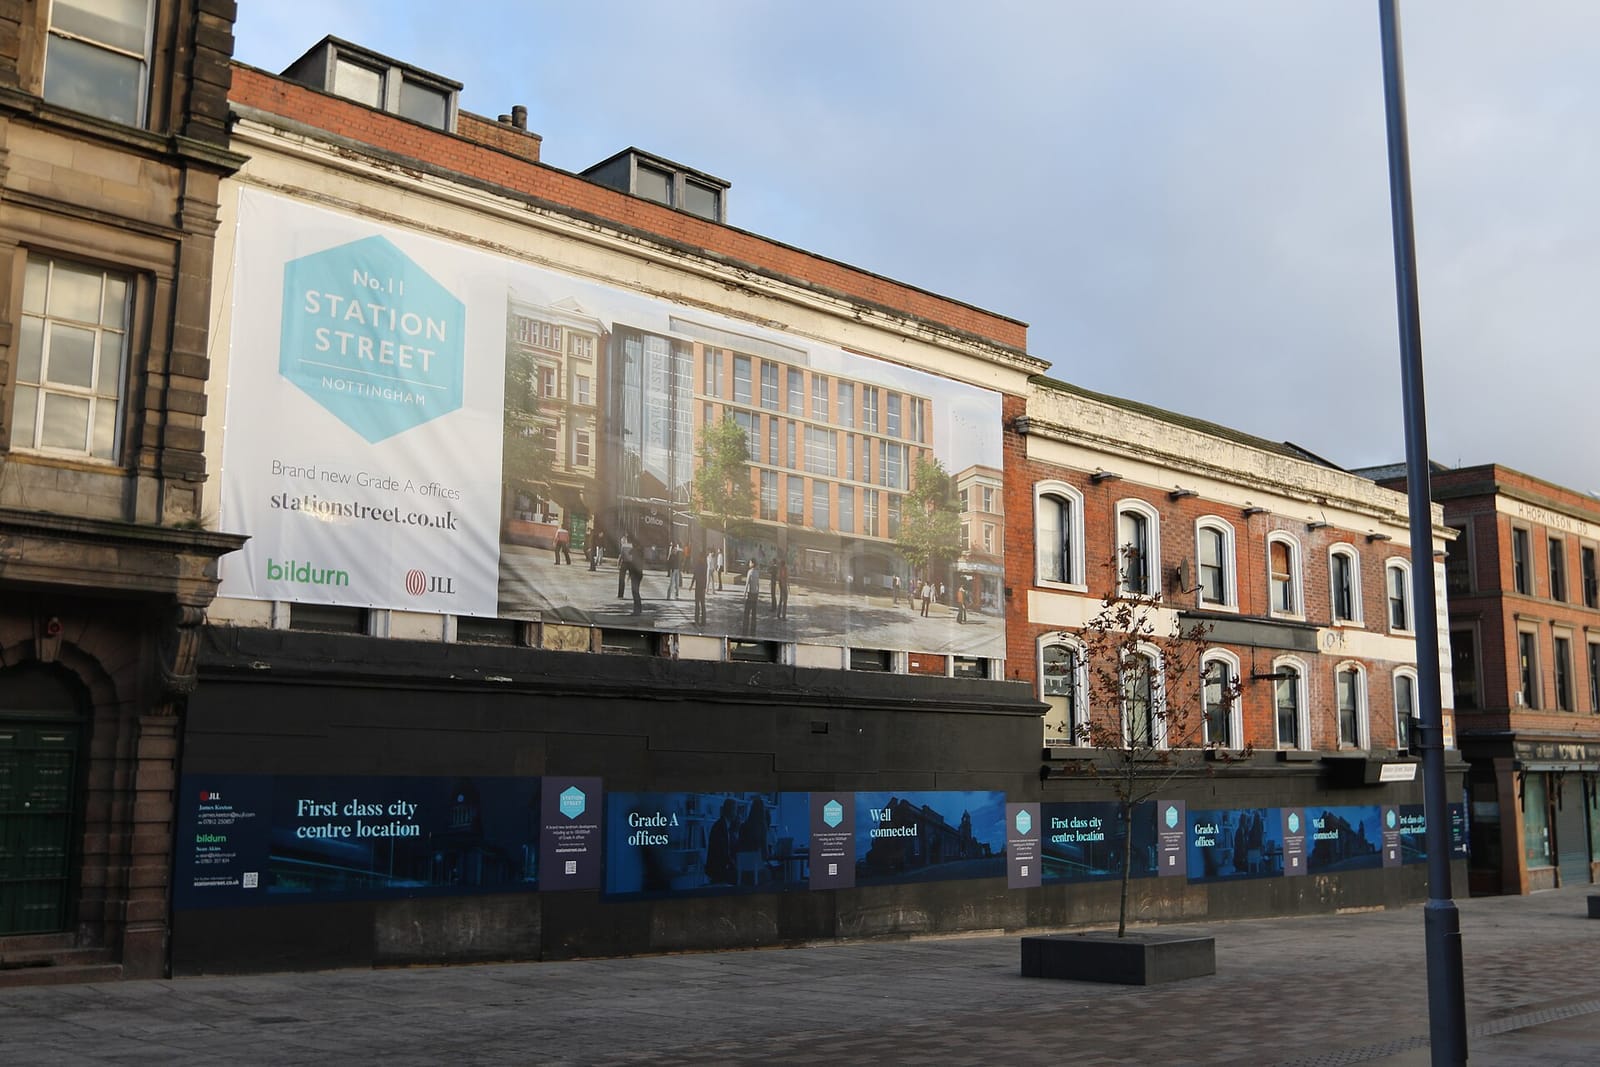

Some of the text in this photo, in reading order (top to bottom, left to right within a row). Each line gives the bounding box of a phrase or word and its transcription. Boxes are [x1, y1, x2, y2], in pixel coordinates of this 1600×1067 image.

[304, 289, 447, 342] STATION
[315, 327, 436, 371] STREET
[322, 375, 426, 405] NOTTINGHAM
[271, 459, 460, 500] Brand new Grade A offices
[271, 493, 458, 530] stationstreet.co.uk
[1518, 503, 1524, 516] H
[1526, 507, 1572, 529] HOPKINSON
[266, 558, 456, 594] bildurn JLL
[209, 792, 221, 800] JLL
[297, 799, 418, 820] First class city
[870, 808, 891, 822] Well
[628, 812, 679, 828] Grade A
[1051, 816, 1103, 830] First class city
[296, 820, 420, 838] centre location
[870, 824, 918, 838] connected
[1051, 833, 1075, 843] centre
[1076, 830, 1105, 842] location
[1194, 823, 1220, 834] Grade A
[196, 834, 227, 843] bildurn
[628, 831, 669, 846] offices
[1194, 836, 1215, 847] offices
